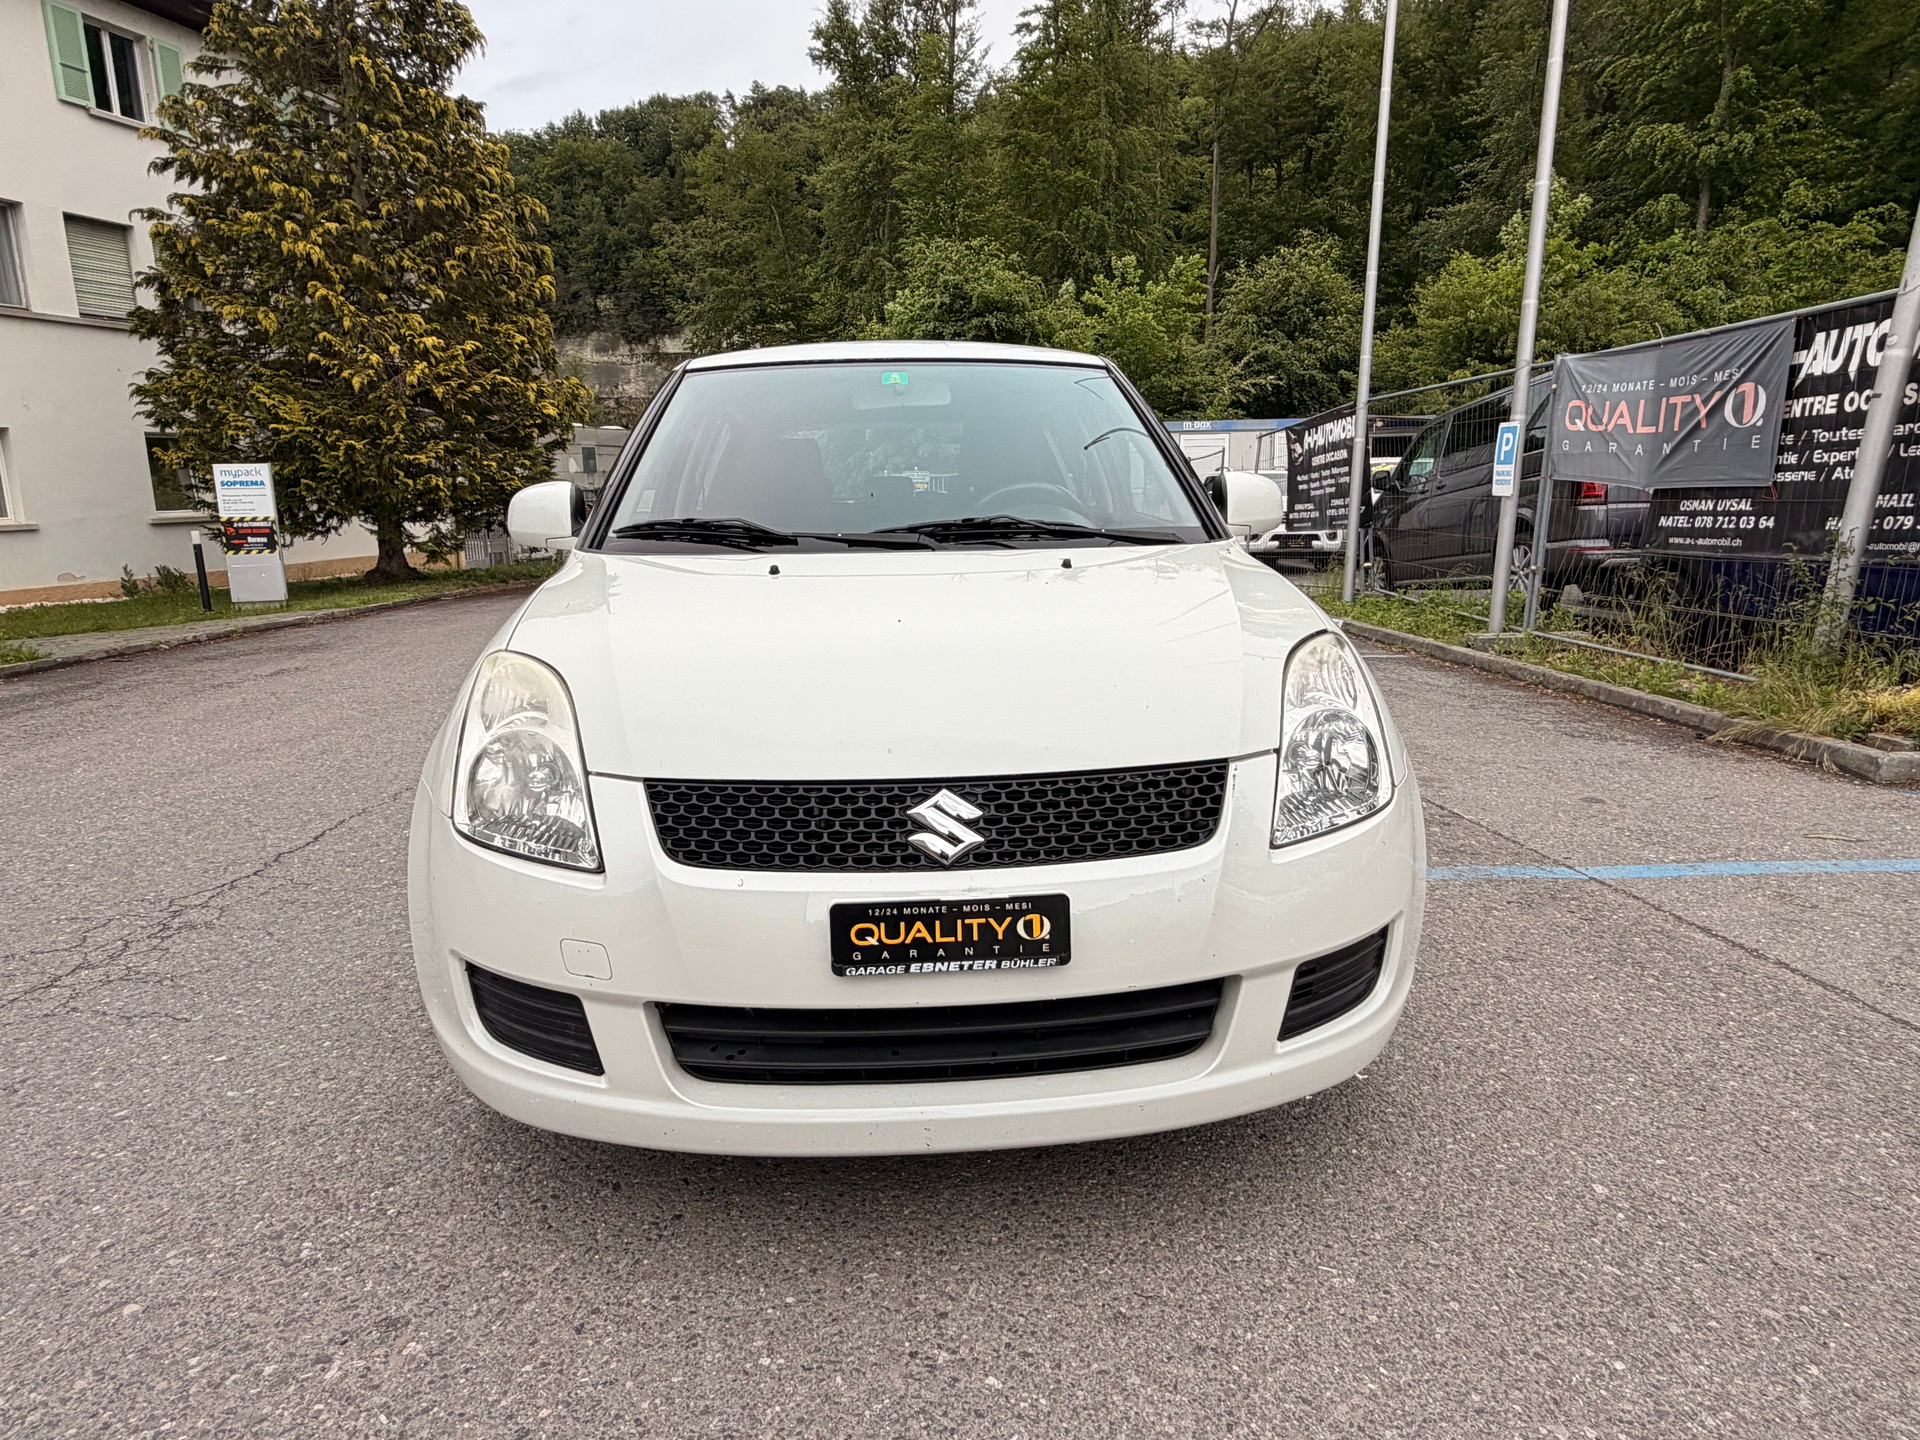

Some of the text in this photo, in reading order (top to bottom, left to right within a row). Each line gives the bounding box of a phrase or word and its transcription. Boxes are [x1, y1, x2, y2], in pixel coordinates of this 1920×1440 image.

[1612, 379, 1656, 393] MONATE
[1669, 375, 1697, 388] MOIS
[1565, 390, 1722, 433] QUALITY
[1782, 393, 1840, 419] ENTRE
[1812, 426, 1866, 444] Toutes
[1500, 432, 1514, 461] P
[1562, 435, 1761, 456] GARANTIE
[1777, 451, 1799, 465] ntie
[1812, 448, 1860, 466] Expert
[220, 467, 262, 478] mypack
[1680, 498, 1754, 511] OSMAN UYSAL
[1875, 493, 1915, 508] MAIL
[1658, 516, 1775, 529] NATEL: 078 712 03 64
[1883, 515, 1914, 530] 079
[868, 907, 898, 916] 12/24
[903, 905, 948, 915] MONATE
[962, 903, 991, 912] MOIS
[1005, 902, 1032, 910] MESI
[850, 917, 1013, 946] QUALITY
[852, 943, 1050, 961] GARANTIE
[845, 958, 1057, 977] GARAGE EBNETER BÜHLER
